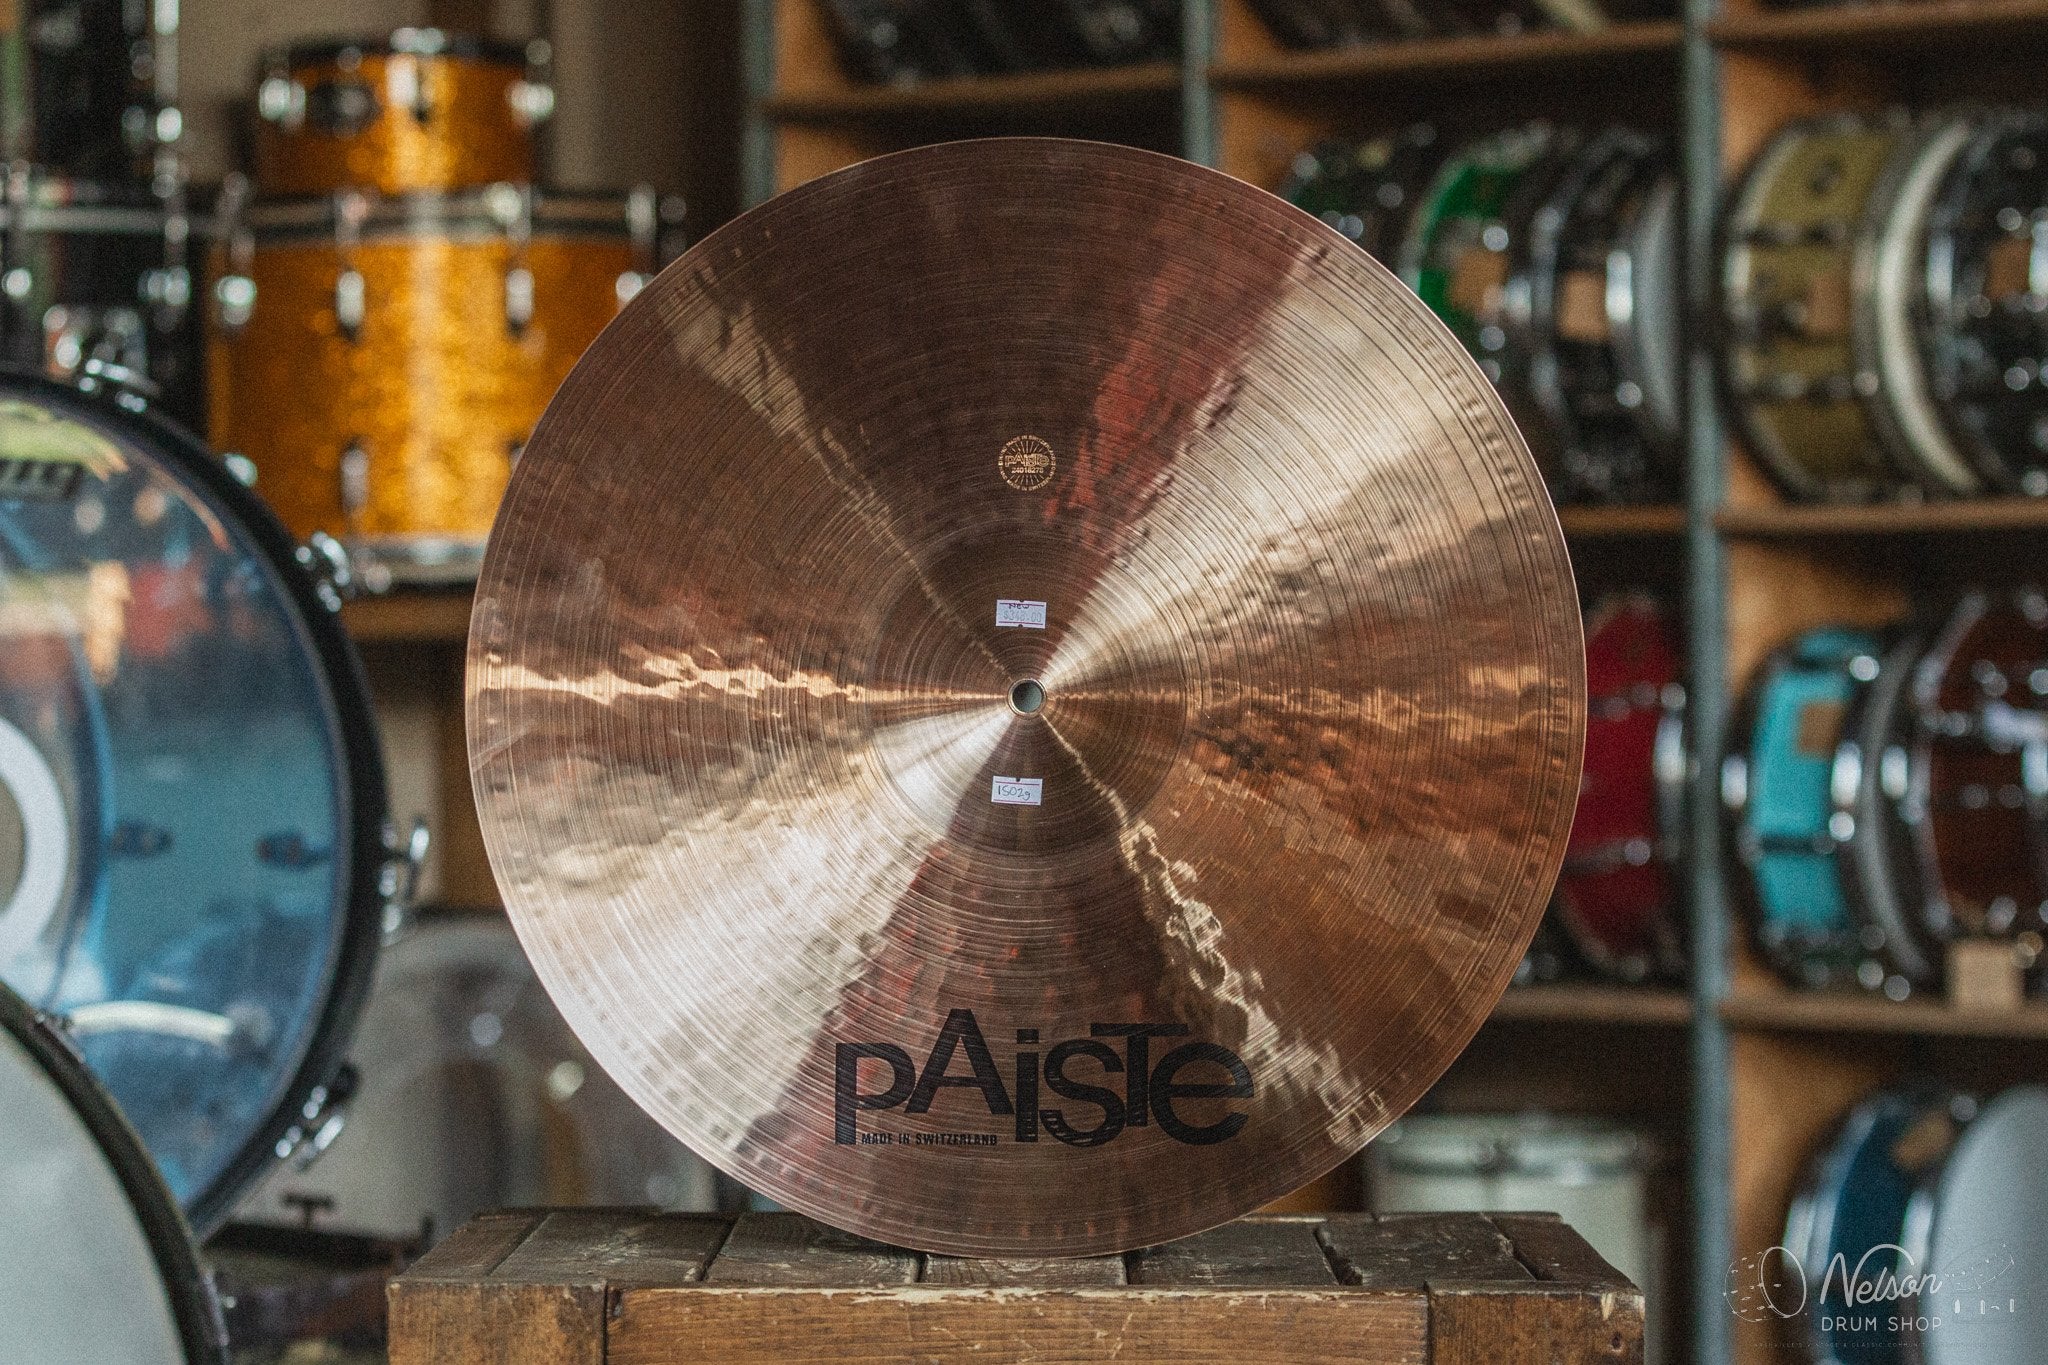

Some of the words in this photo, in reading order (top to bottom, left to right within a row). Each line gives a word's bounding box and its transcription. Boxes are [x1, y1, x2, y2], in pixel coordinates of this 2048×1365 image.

[861, 1133, 893, 1144] MADE
[898, 1133, 910, 1144] IN
[915, 1132, 998, 1145] SWITZERLAND
